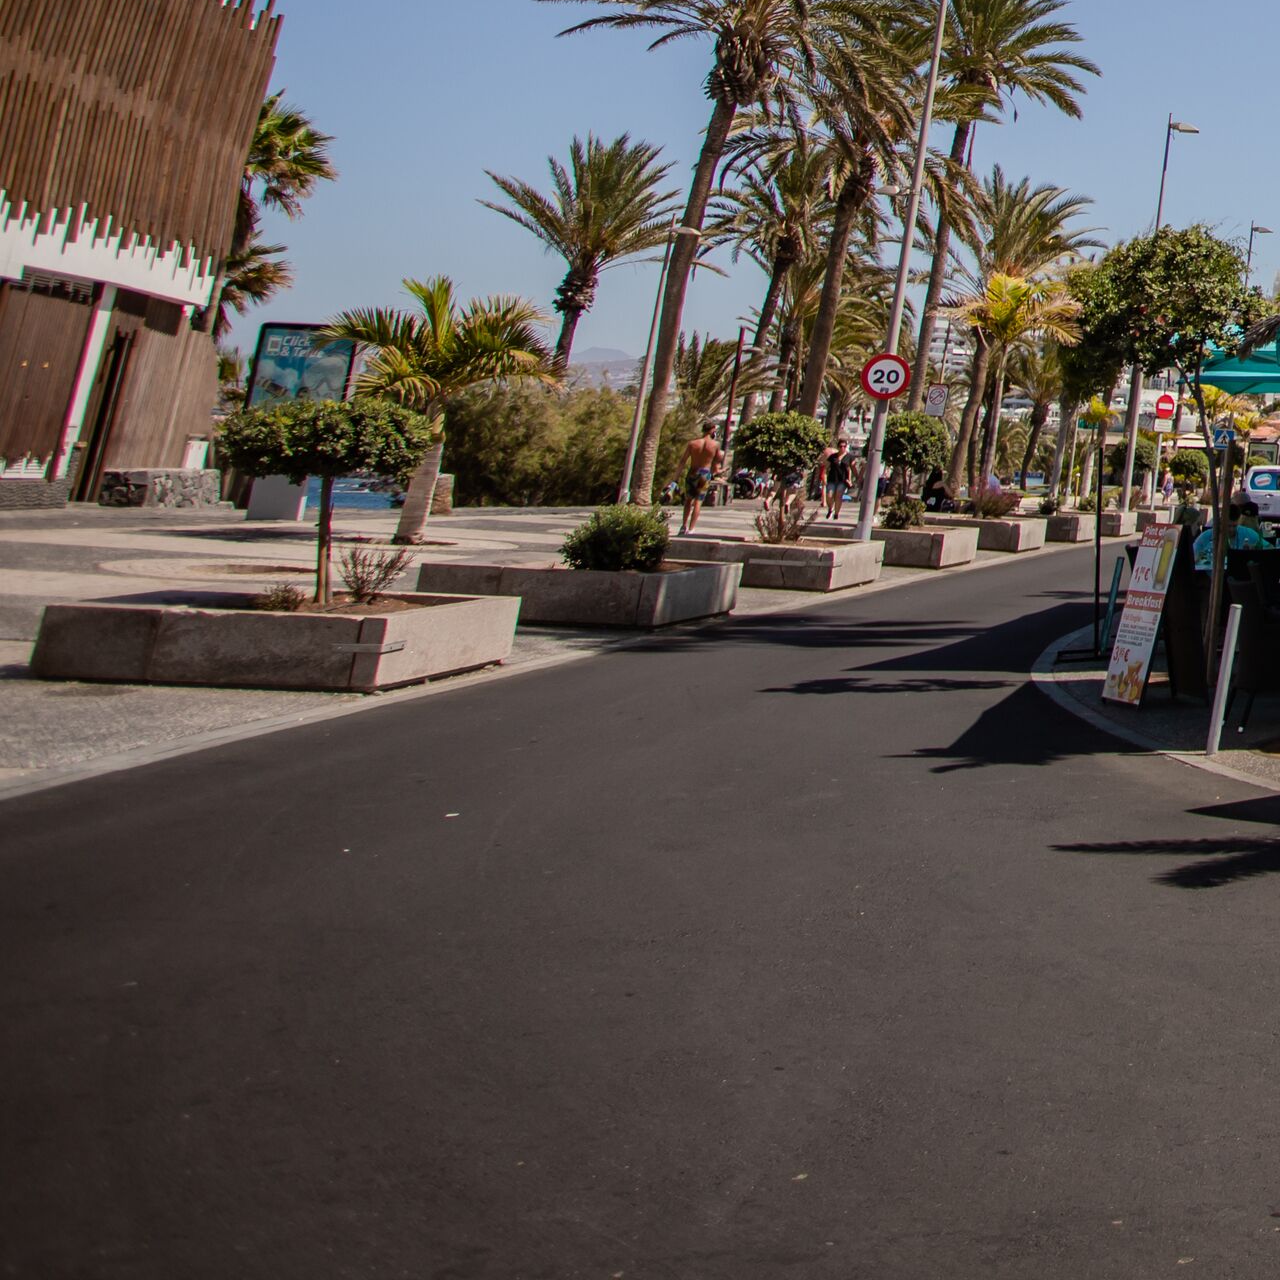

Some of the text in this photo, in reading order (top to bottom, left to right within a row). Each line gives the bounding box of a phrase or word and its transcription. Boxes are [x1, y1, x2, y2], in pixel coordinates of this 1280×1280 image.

[873, 370, 899, 384] 20
[1145, 526, 1157, 535] Pint
[1127, 594, 1162, 608] Breakfast
